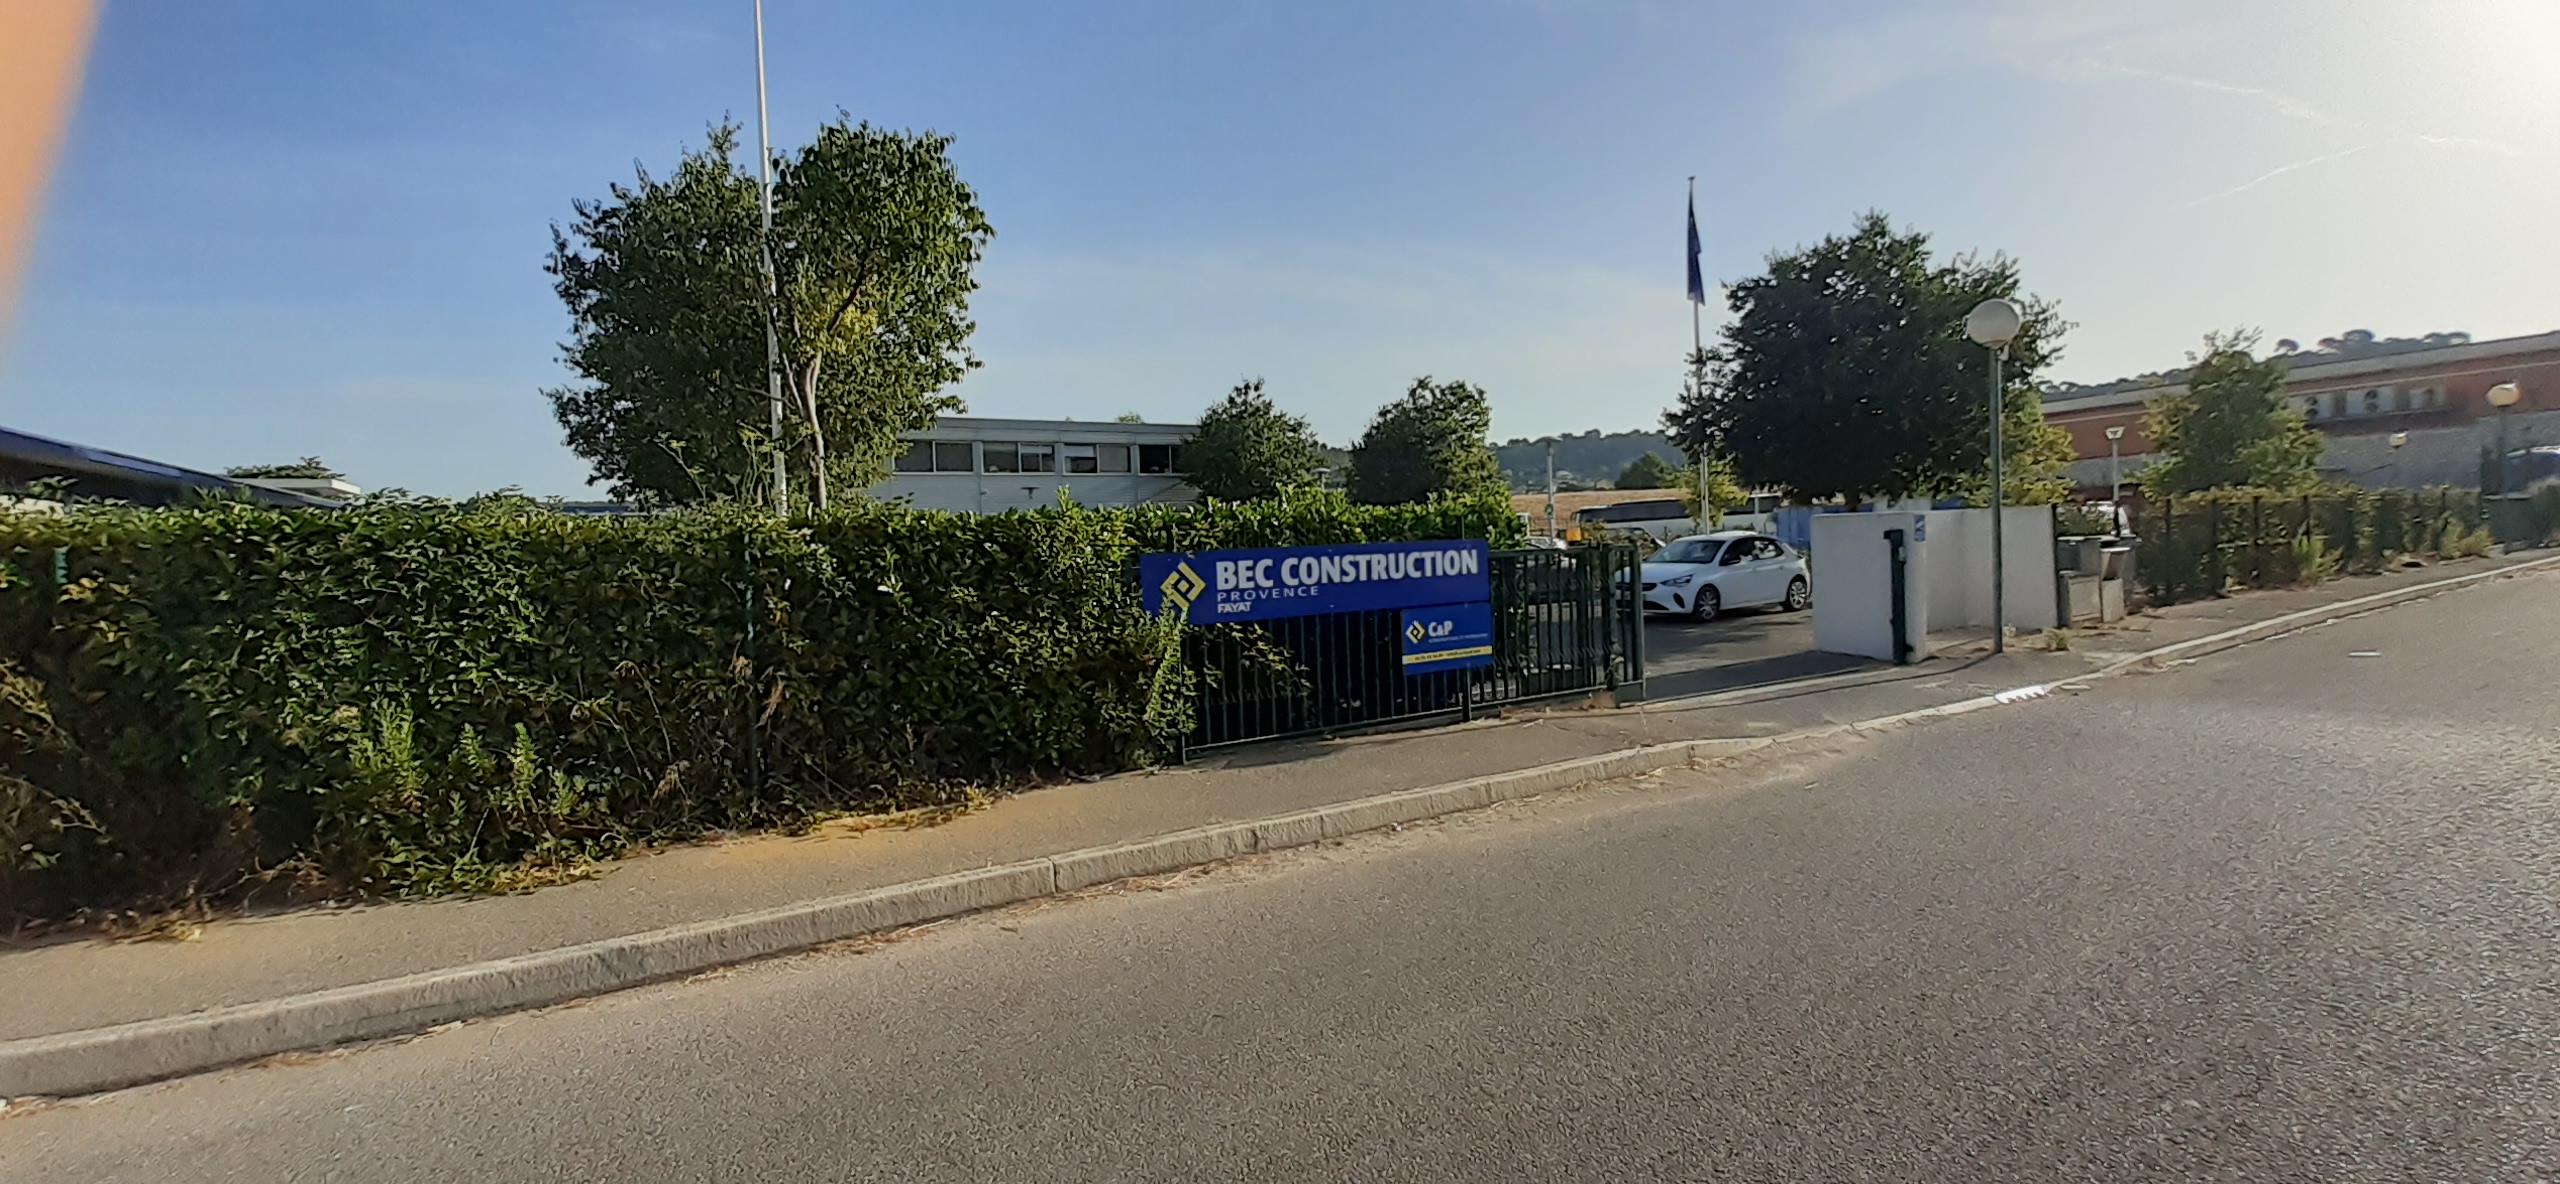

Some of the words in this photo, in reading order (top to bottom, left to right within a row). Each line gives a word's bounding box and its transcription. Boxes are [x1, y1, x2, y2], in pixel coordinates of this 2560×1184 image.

[1216, 558, 1274, 590] BEC
[1281, 549, 1478, 587] CONSTRUCTION
[1217, 585, 1319, 602] PROVENCE
[1217, 602, 1252, 614] FAYAT
[1428, 620, 1454, 637] C&P
